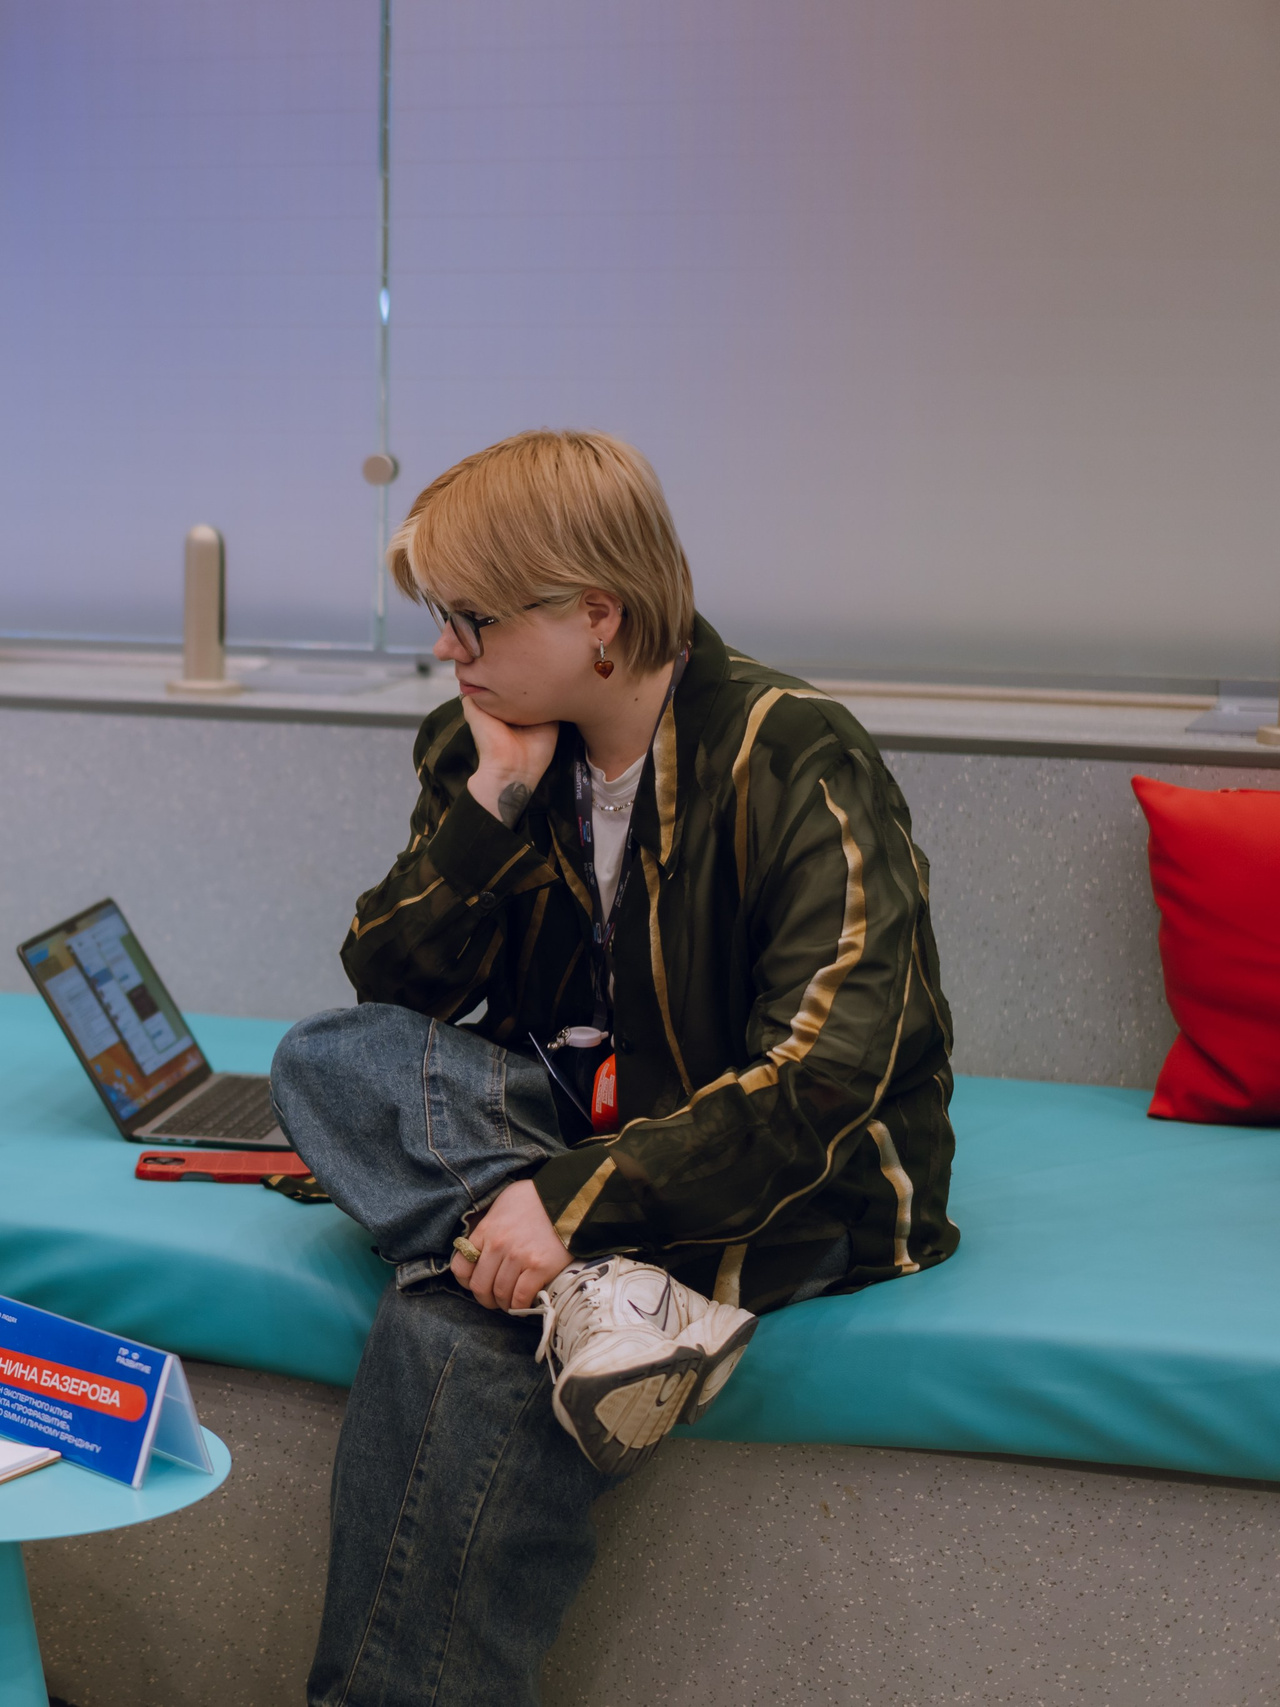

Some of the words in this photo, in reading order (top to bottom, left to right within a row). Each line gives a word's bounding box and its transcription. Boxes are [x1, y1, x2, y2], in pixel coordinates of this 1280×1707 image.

[116, 1355, 152, 1375] РАЗВИТИЕ
[4, 1388, 50, 1411] ЭКСПЕРТНОГО
[49, 1405, 73, 1420] КЛУБА
[40, 1369, 121, 1407] БАЗЕРОВА
[20, 1415, 26, 1425] И
[25, 1417, 60, 1438] ЛИЧНОМУ
[60, 1431, 102, 1454] БРЕНДИНГУ
